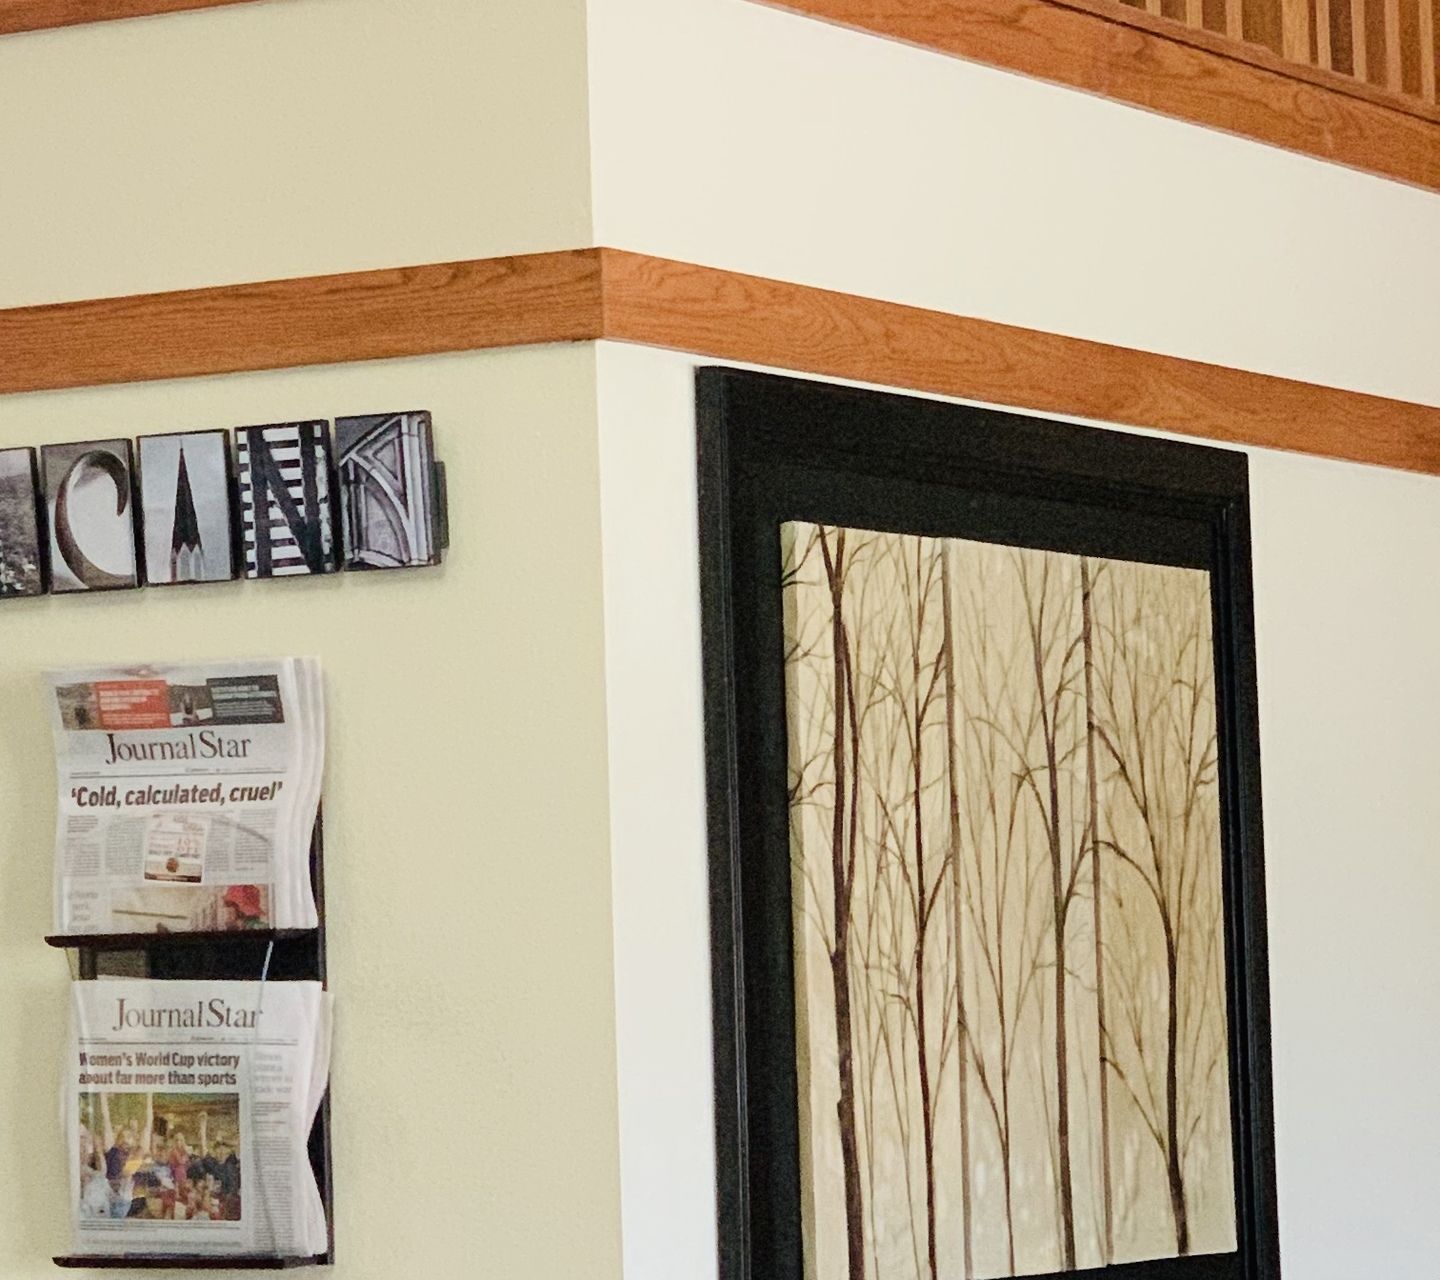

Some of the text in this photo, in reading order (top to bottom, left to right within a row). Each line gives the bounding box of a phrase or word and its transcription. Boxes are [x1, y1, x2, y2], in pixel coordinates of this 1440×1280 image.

[105, 729, 252, 765] Journal Star
[125, 783, 227, 807] calculated,
[112, 997, 264, 1031] Journal Star
[135, 1052, 171, 1068] World
[171, 1052, 195, 1070] Cup
[196, 1052, 241, 1071] victory
[78, 1069, 237, 1087] about far more than sports
